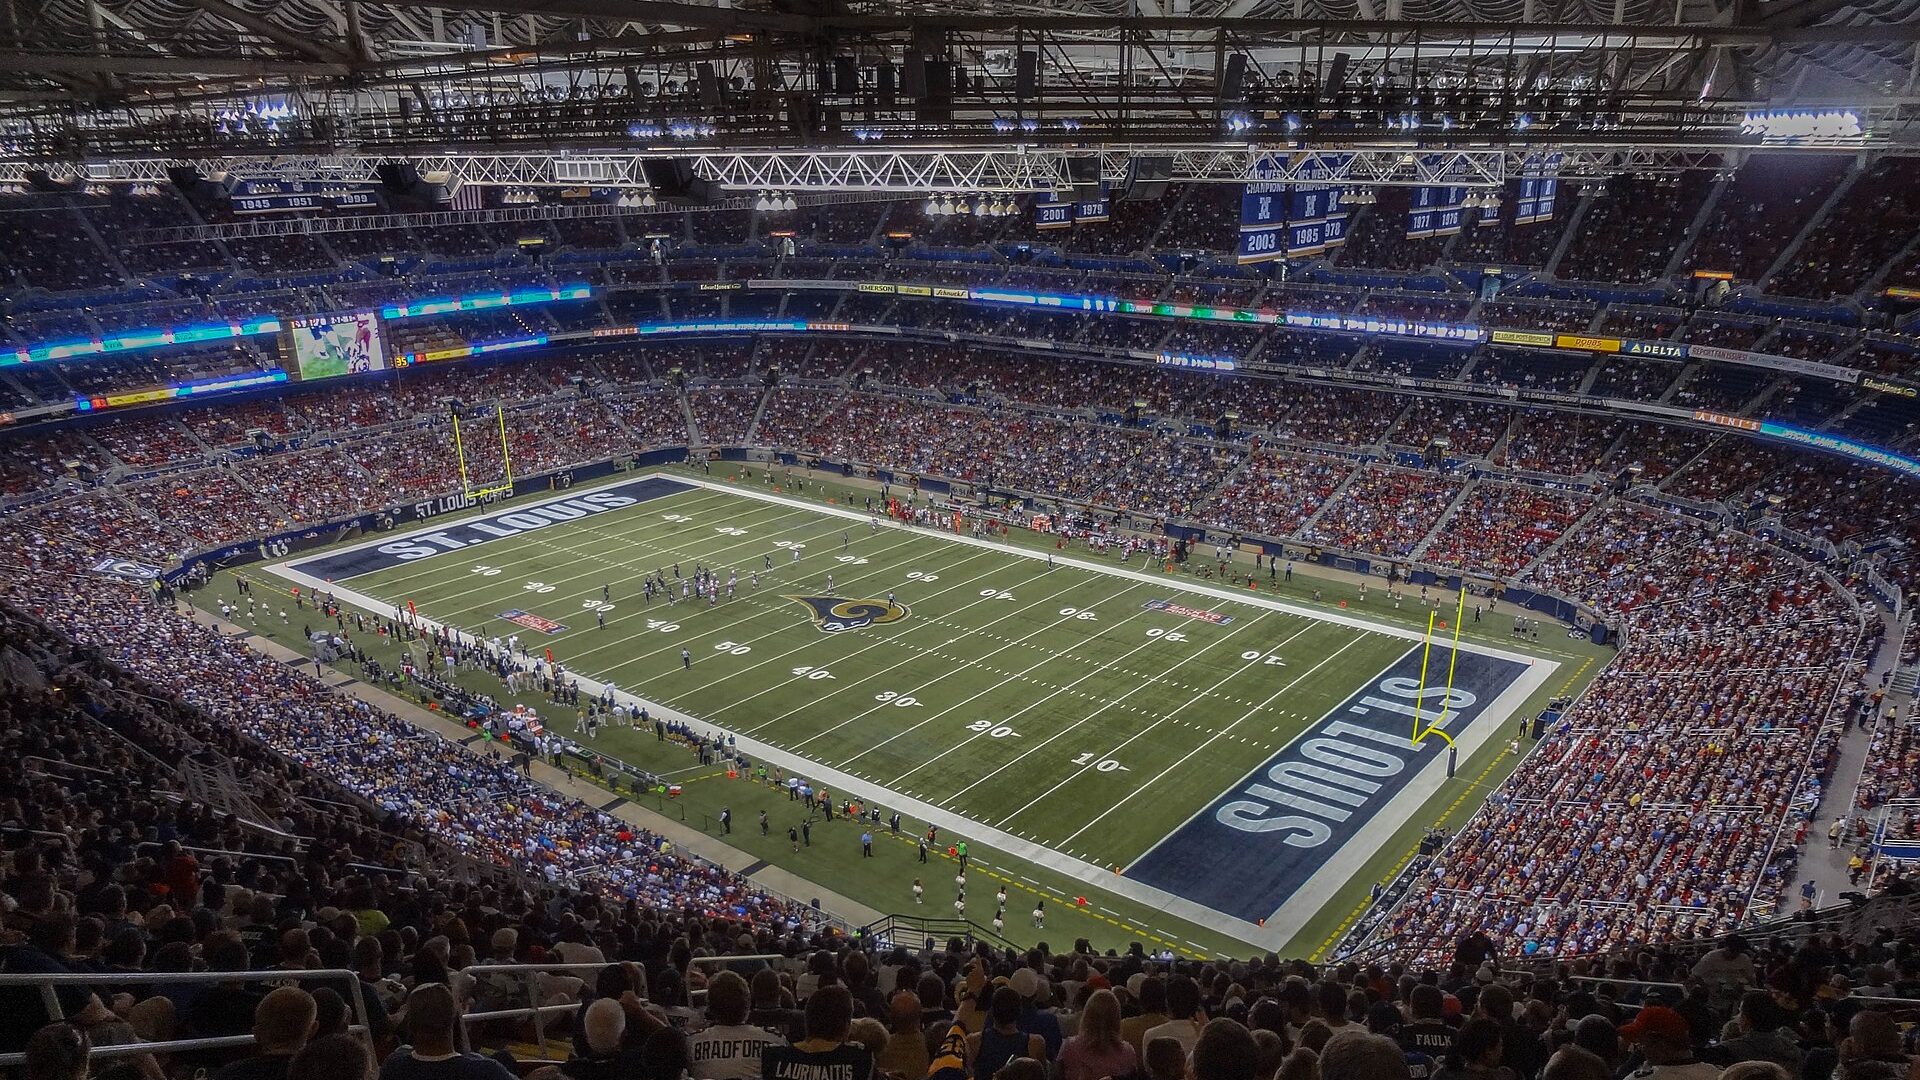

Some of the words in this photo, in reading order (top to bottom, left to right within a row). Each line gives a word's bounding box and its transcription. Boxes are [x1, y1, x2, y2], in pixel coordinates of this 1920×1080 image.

[241, 199, 271, 209] 1945
[288, 197, 312, 207] 1951
[343, 194, 368, 204] 1999
[1043, 209, 1065, 221] 2001
[1082, 204, 1103, 215] 1979
[1413, 215, 1430, 229] 1977
[1442, 212, 1458, 226] 1976
[1296, 228, 1319, 245] 1985
[1325, 222, 1341, 237] 978
[1248, 233, 1276, 251] 2003
[1643, 345, 1681, 357] DELTA
[415, 501, 437, 518] ST.
[439, 492, 476, 512] LOUIS
[378, 531, 482, 560] ST.
[468, 491, 638, 536] LOUIS
[906, 571, 939, 583] 50
[647, 618, 680, 633] 40
[1146, 628, 1186, 641] 20
[715, 641, 751, 656] 50
[1241, 649, 1281, 666] 10
[793, 666, 829, 681] 40
[876, 690, 916, 707] 30
[1349, 677, 1476, 729] ST.
[967, 720, 1013, 738] 20
[1071, 751, 1120, 772] 10
[1216, 720, 1426, 848] LOUIS
[1415, 1033, 1452, 1047] FAULK
[775, 1061, 854, 1080] LAURINAITIS
